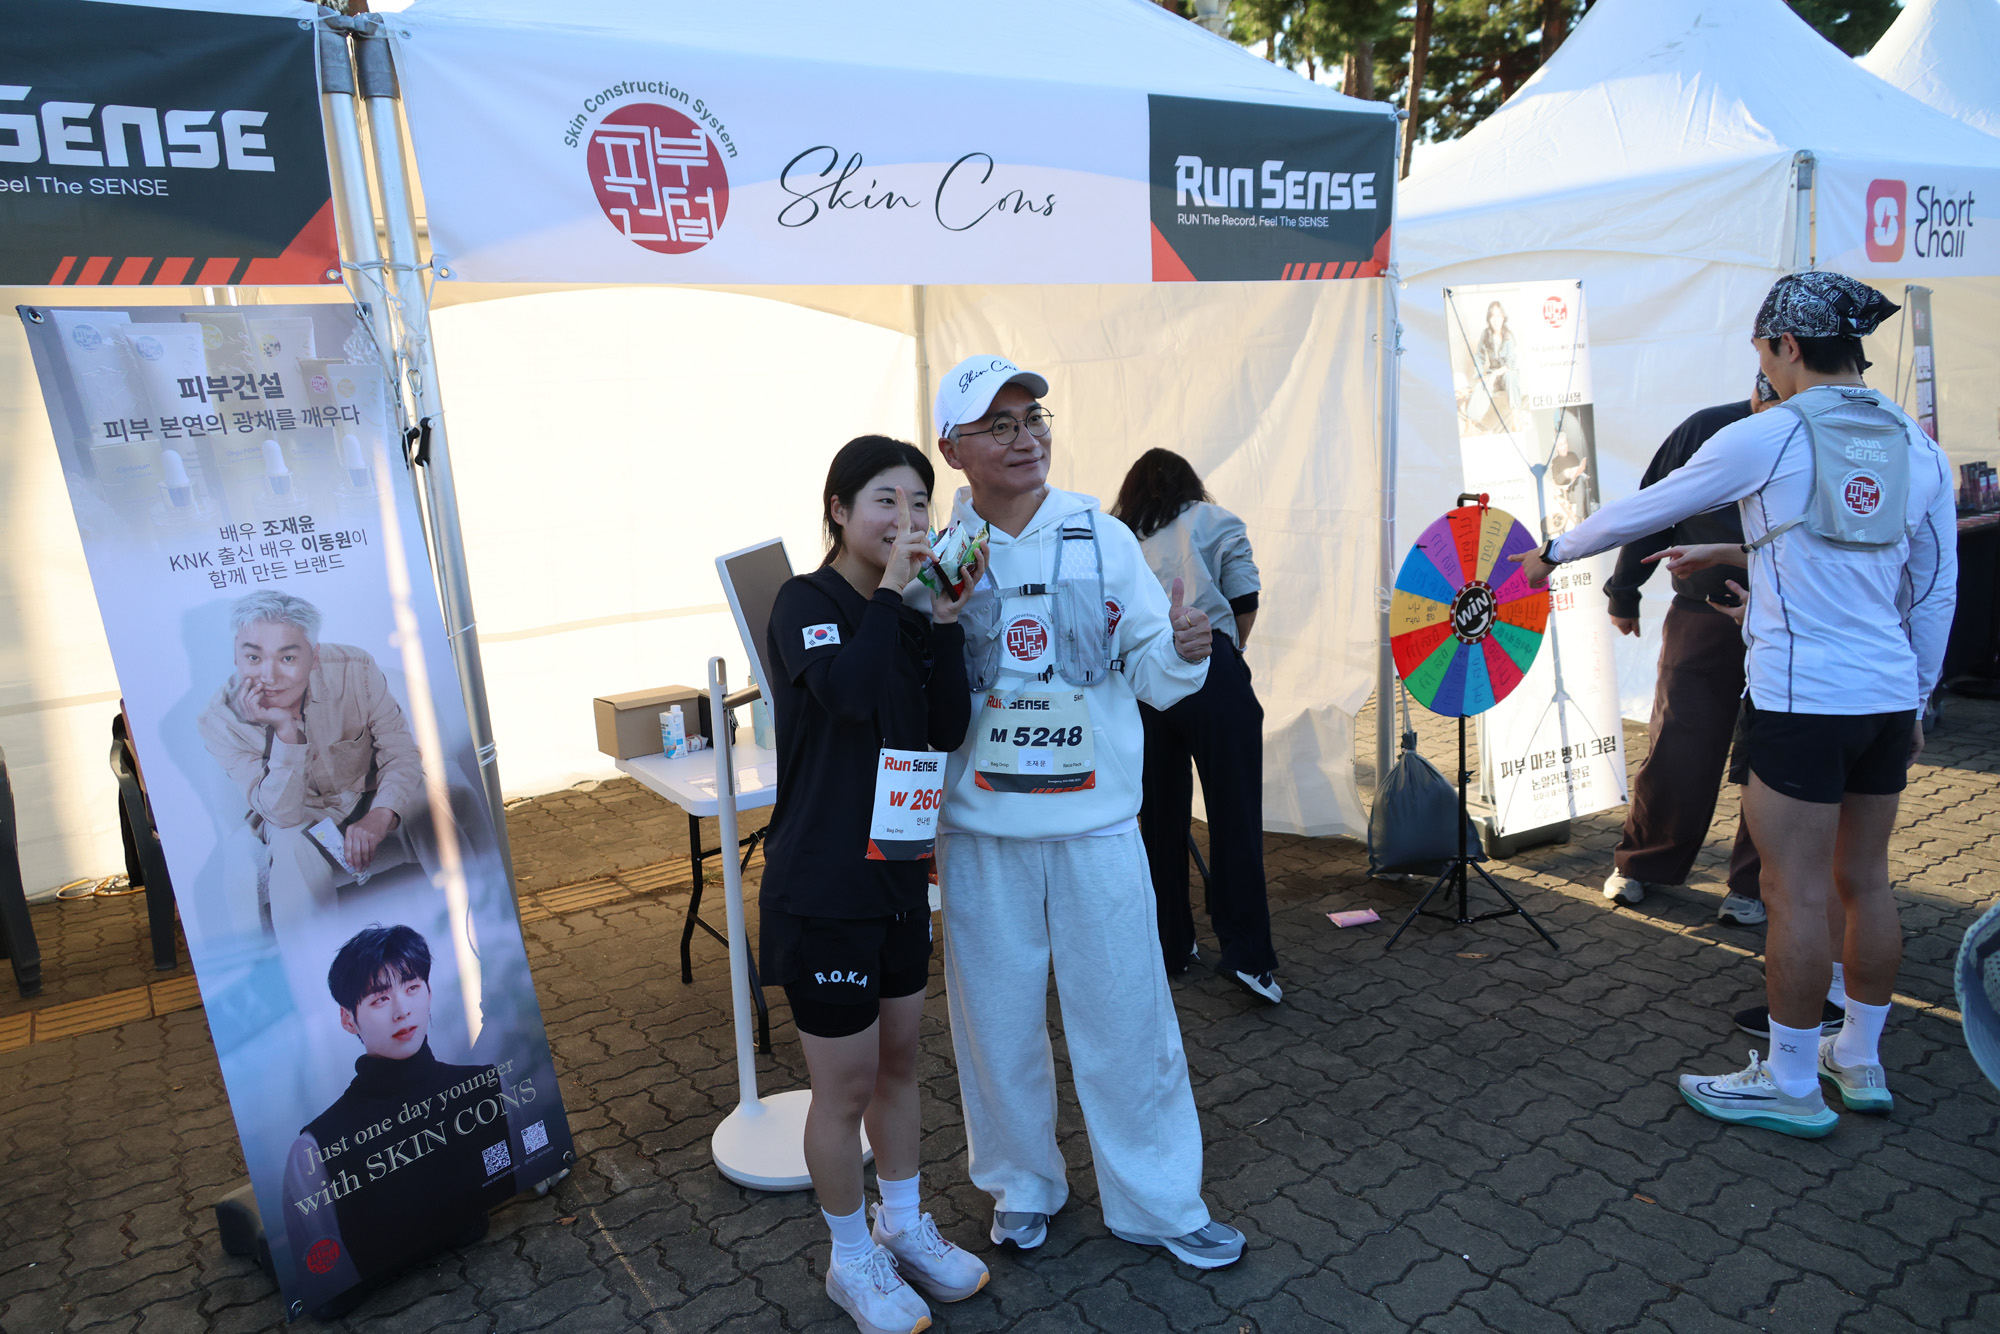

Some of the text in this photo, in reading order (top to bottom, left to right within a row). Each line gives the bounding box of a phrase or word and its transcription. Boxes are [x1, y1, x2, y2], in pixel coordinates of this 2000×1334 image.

[564, 80, 738, 158] Skin Construction System
[0, 176, 169, 196] eel The SENSE
[777, 145, 1057, 231] Skin Cons
[1177, 213, 1329, 228] RUN The Record, Feel The SENSE
[1915, 185, 1975, 227] Short
[177, 372, 285, 403] 피부건설
[958, 368, 989, 394] Skin
[103, 404, 361, 443] 피부 본연의 광채를 깨우다
[219, 515, 316, 543] 배우 조재윤
[169, 528, 369, 572] KNK 출신 배우 이동원이
[208, 553, 345, 590] 함께 만든 브랜드
[990, 725, 1083, 747] M 5248
[1501, 735, 1617, 779] 피부 마찰 방지 크림
[889, 790, 909, 807] W
[304, 1057, 514, 1176] Just one day younger
[294, 1077, 538, 1217] with SKIN CONS
